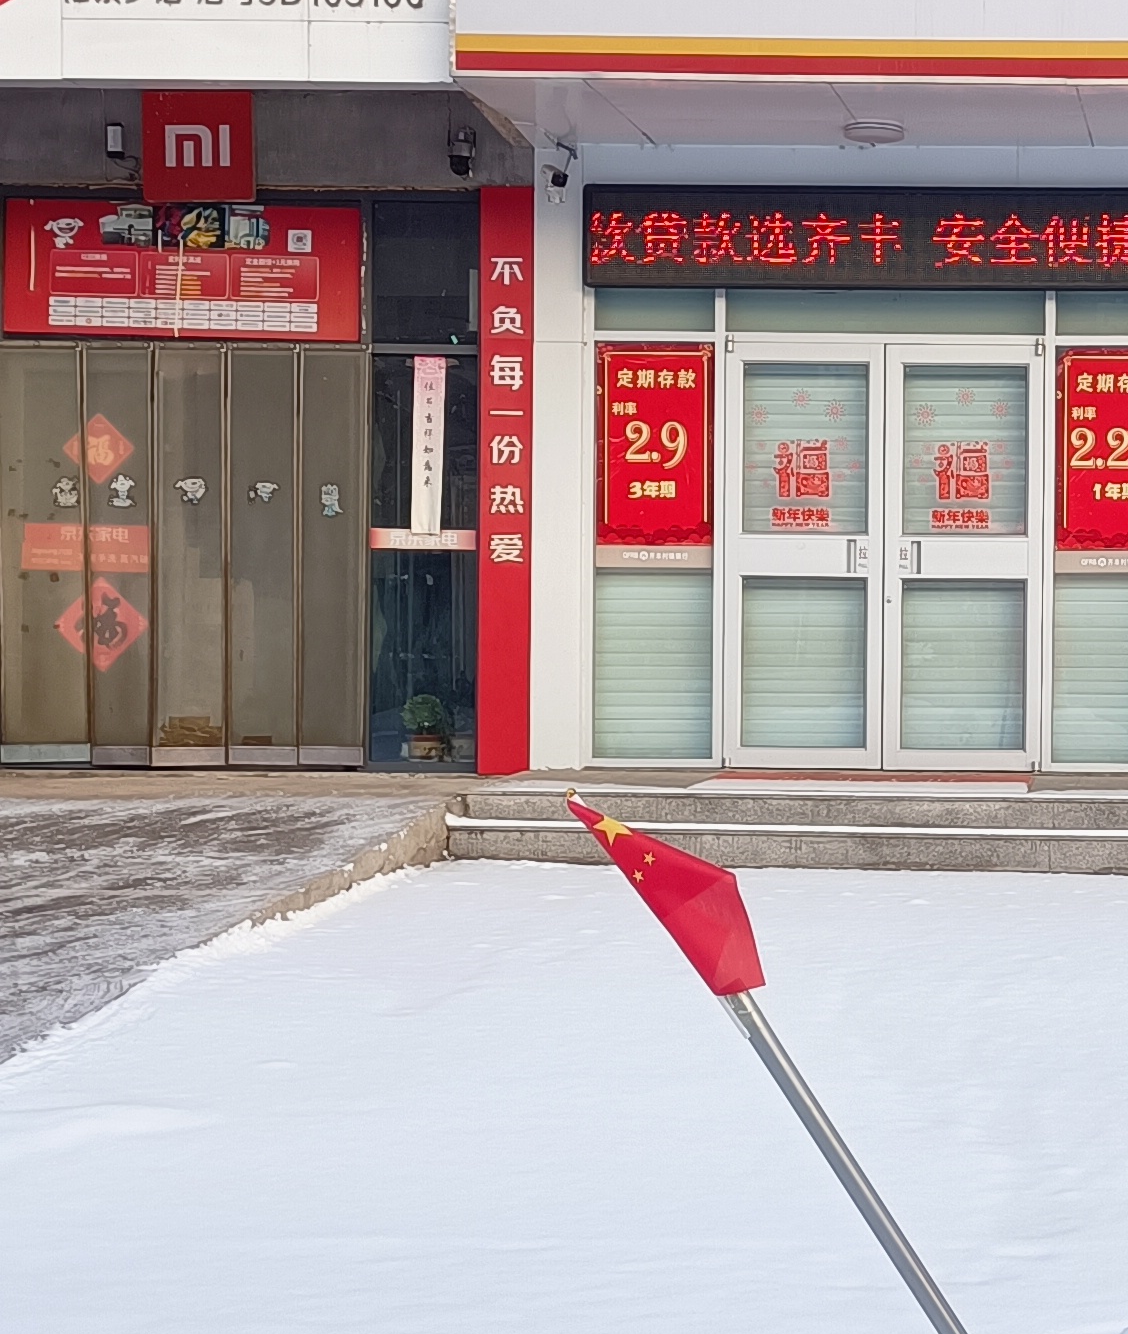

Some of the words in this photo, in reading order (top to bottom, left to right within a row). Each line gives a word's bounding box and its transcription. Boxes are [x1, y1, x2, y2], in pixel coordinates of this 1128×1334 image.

[616, 367, 697, 389] 定期存款
[489, 256, 524, 563] 不负每一份热爱
[611, 402, 638, 416] 利率
[1070, 406, 1097, 421] 利率
[625, 420, 688, 470] 2.9
[627, 480, 677, 499] 3年期
